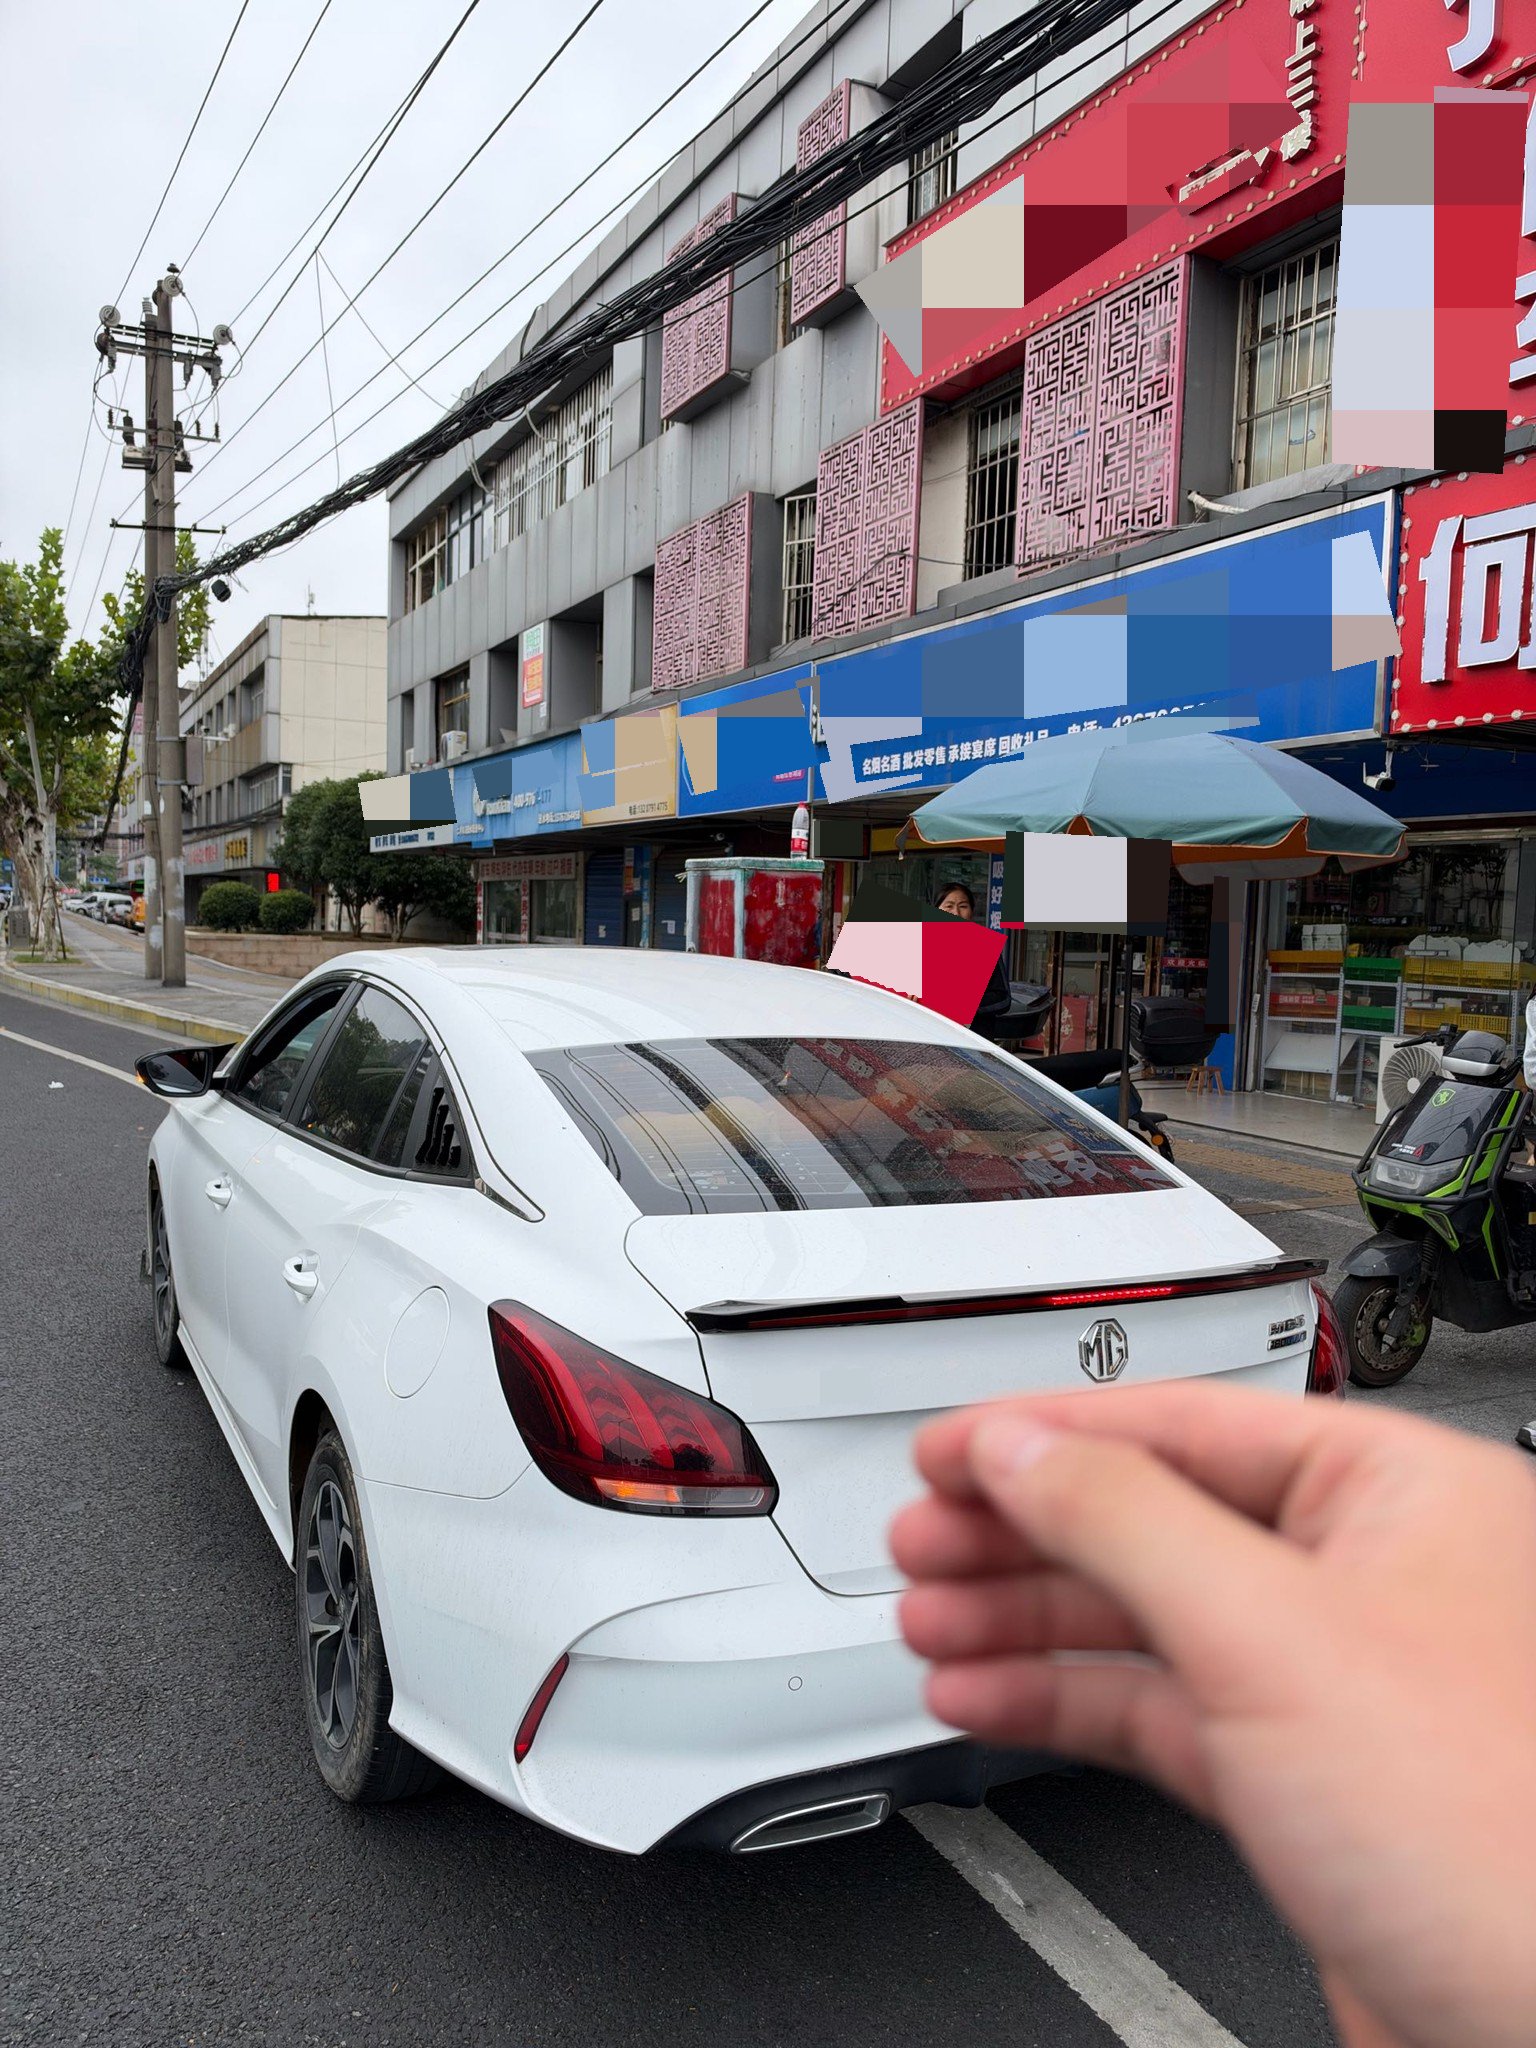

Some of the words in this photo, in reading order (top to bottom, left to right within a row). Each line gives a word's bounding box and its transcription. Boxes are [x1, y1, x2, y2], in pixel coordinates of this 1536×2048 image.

[862, 753, 901, 776] 名烟名酒
[902, 745, 946, 771] 批发零售
[948, 737, 996, 764] 承接宴席
[991, 860, 1004, 929] 吸好烟
[1083, 1320, 1126, 1380] MG
